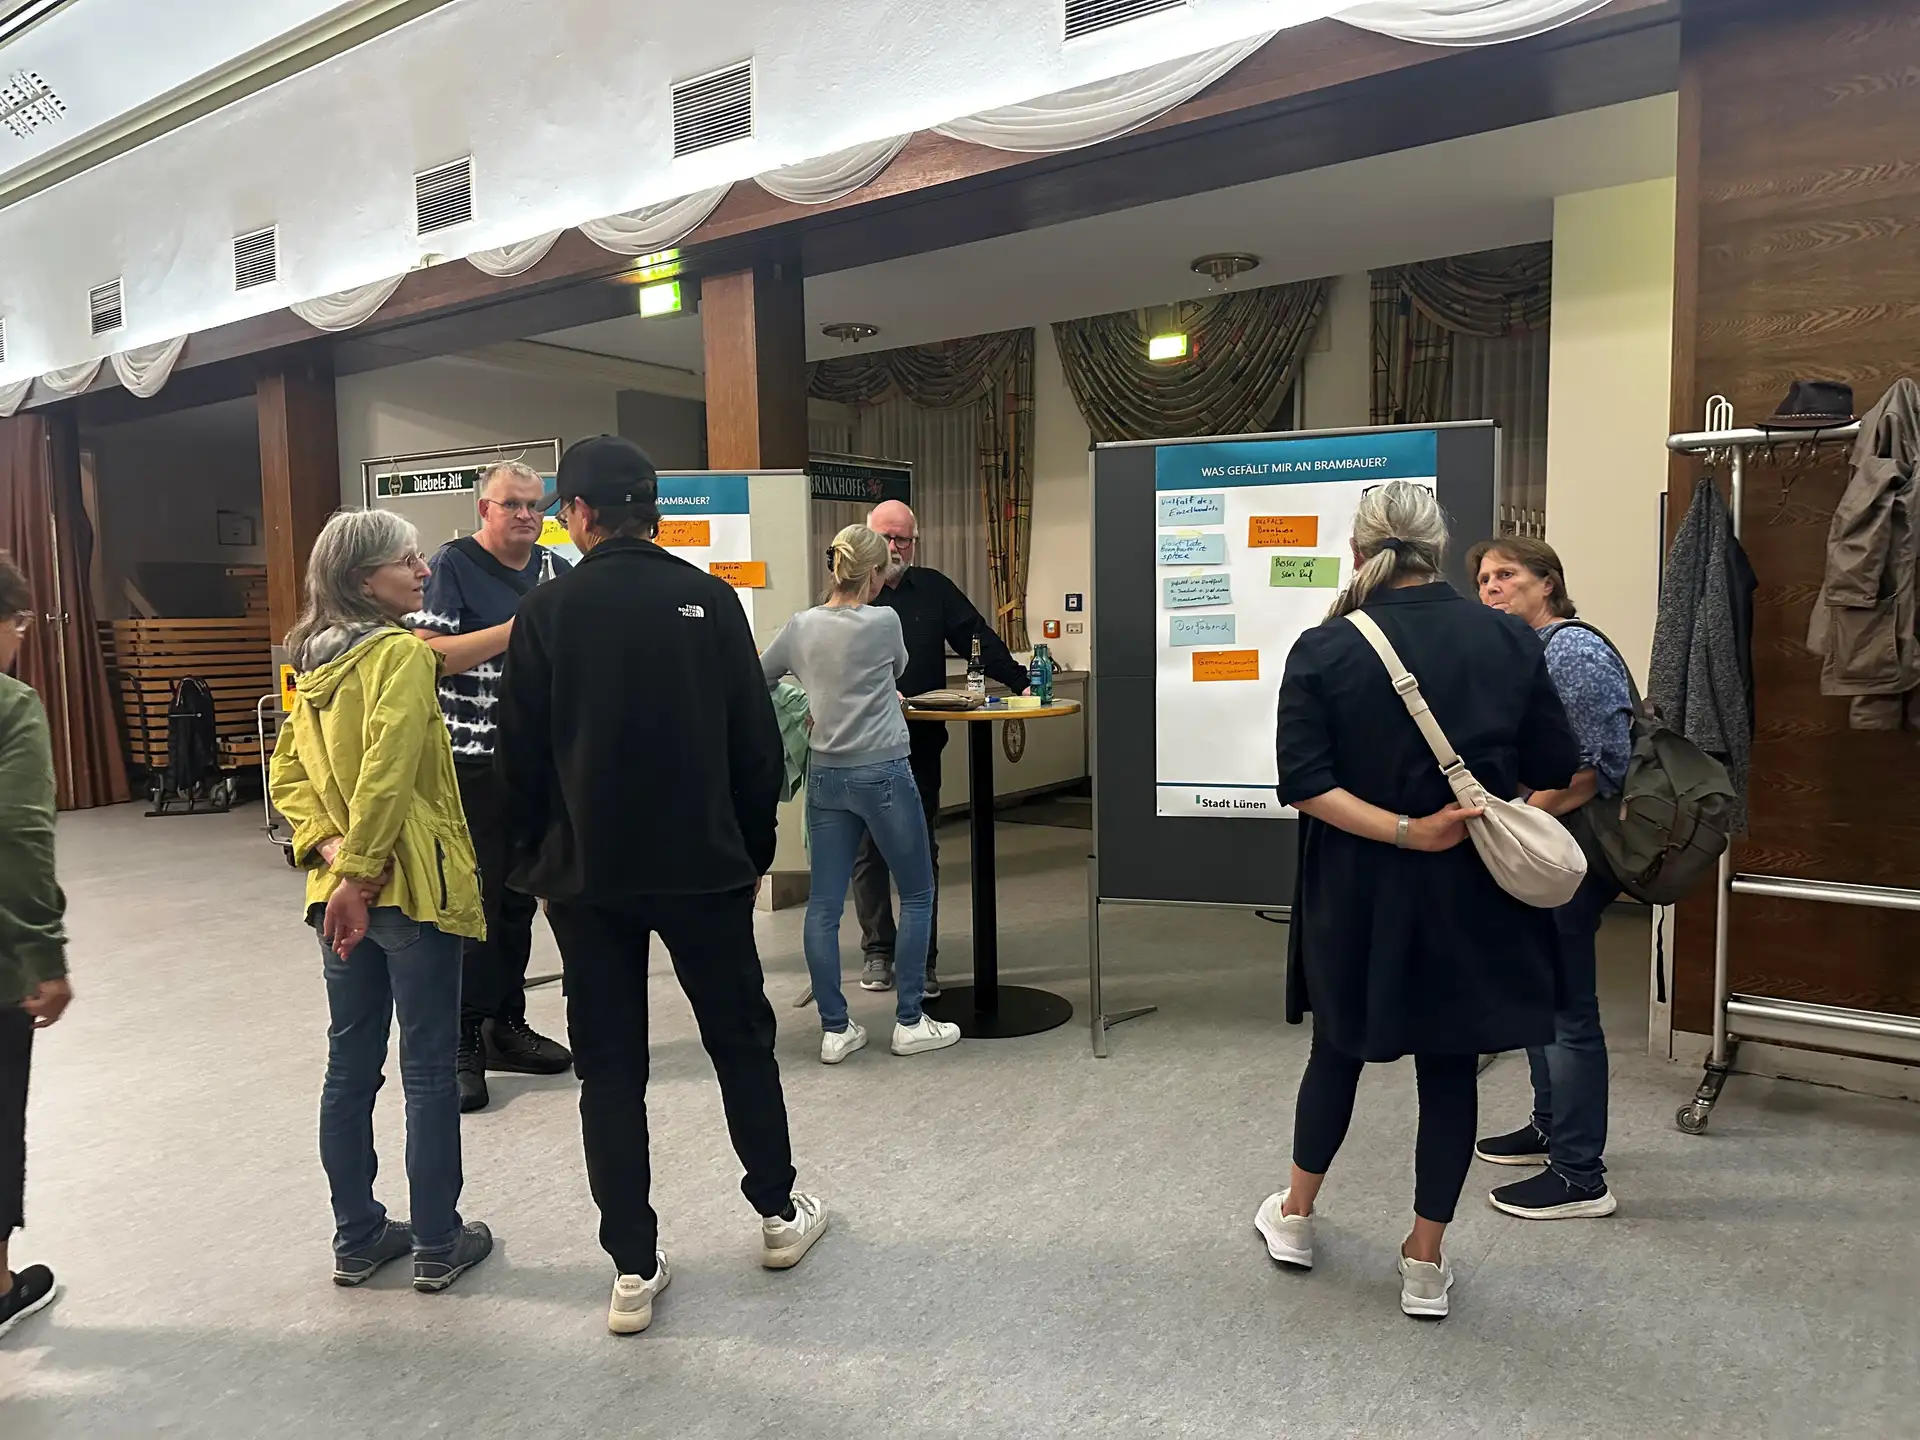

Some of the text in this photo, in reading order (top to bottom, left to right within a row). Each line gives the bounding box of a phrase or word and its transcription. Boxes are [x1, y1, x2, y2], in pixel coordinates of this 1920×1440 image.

[1201, 456, 1388, 477] WAS GEFÄLLT MIR AN BRAMBAUER?
[413, 473, 447, 492] Diebels
[448, 472, 463, 489] Alt
[1201, 798, 1267, 809] Stadt Lünen
